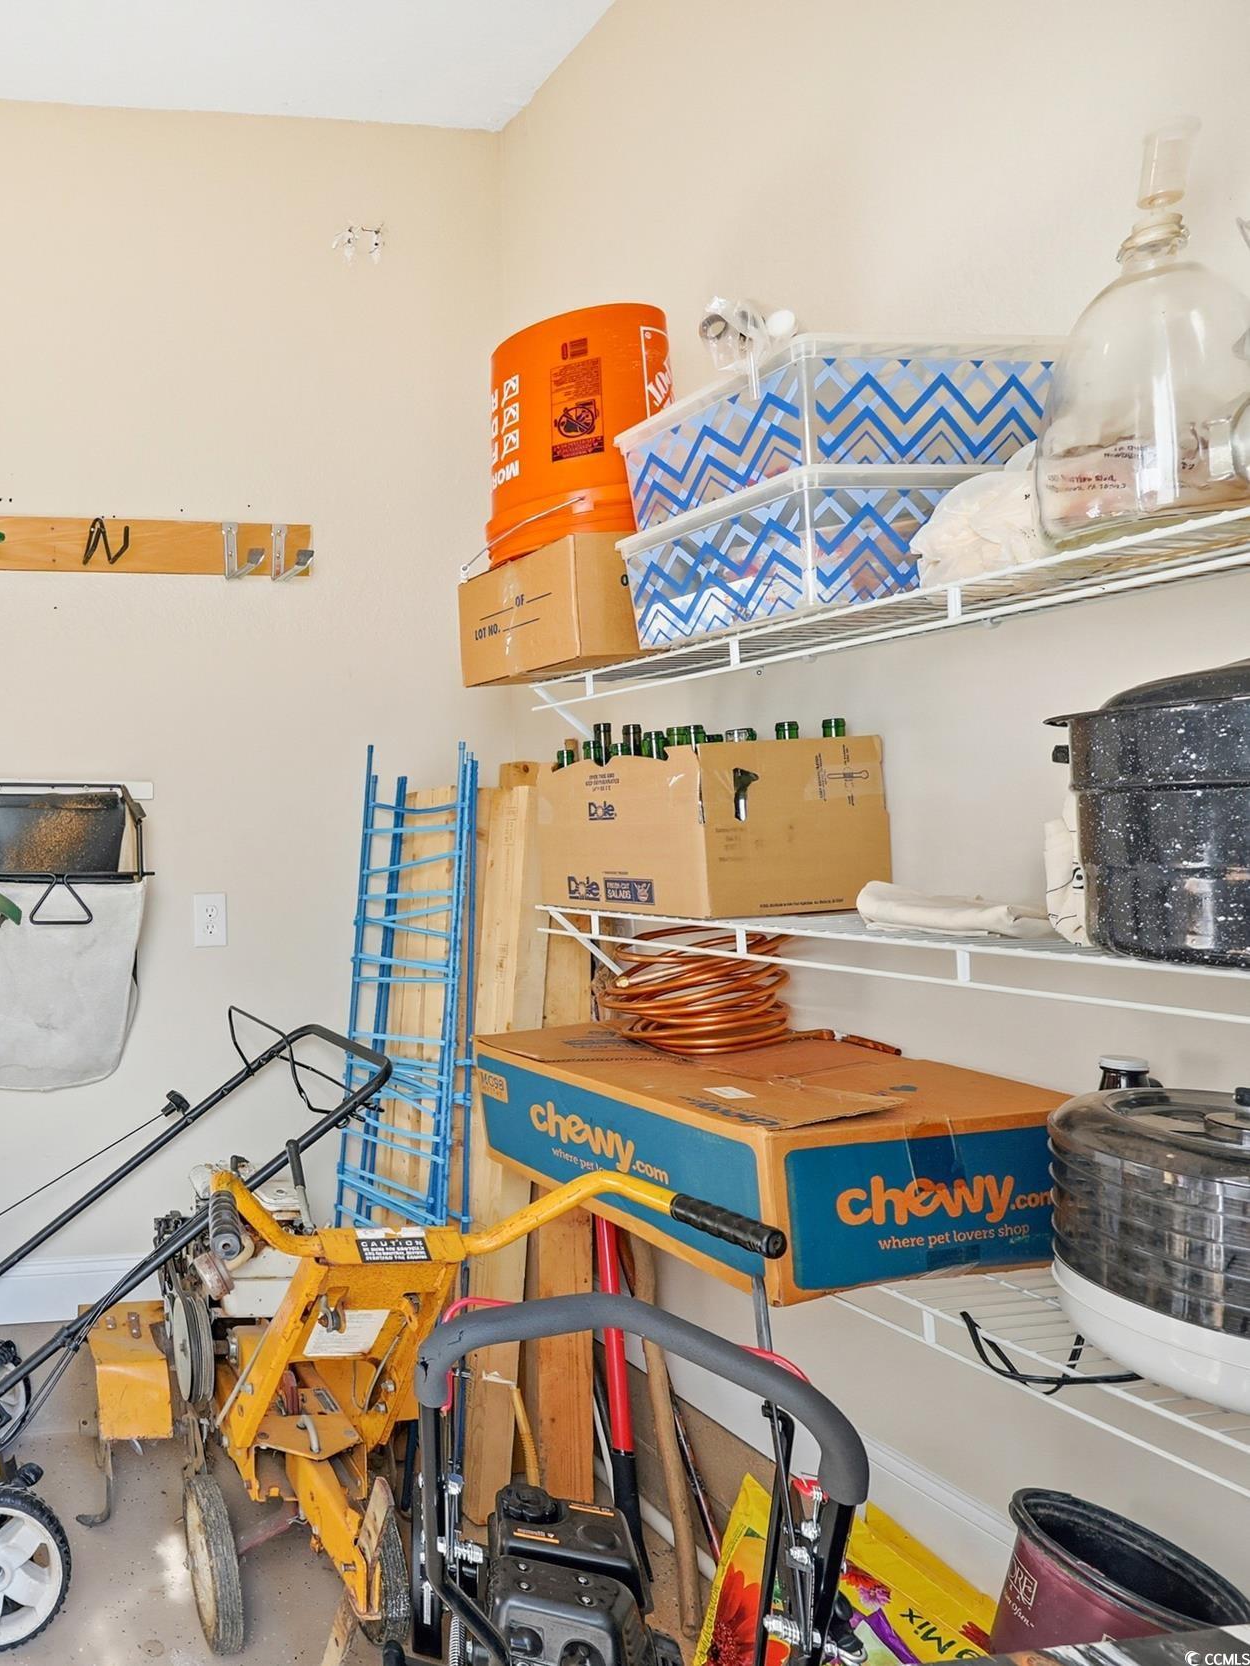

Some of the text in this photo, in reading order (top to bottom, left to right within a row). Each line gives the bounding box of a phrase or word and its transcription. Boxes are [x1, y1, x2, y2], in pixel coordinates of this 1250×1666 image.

[491, 460, 519, 491] MOR
[514, 593, 525, 607] OF
[474, 623, 501, 641] LOT NO.
[588, 801, 616, 820] Dole
[567, 875, 600, 900] Dole
[552, 1147, 579, 1166] where
[579, 1158, 595, 1171] pet
[878, 1223, 1030, 1250] where pet lovers shop
[900, 1608, 956, 1655] Mix
